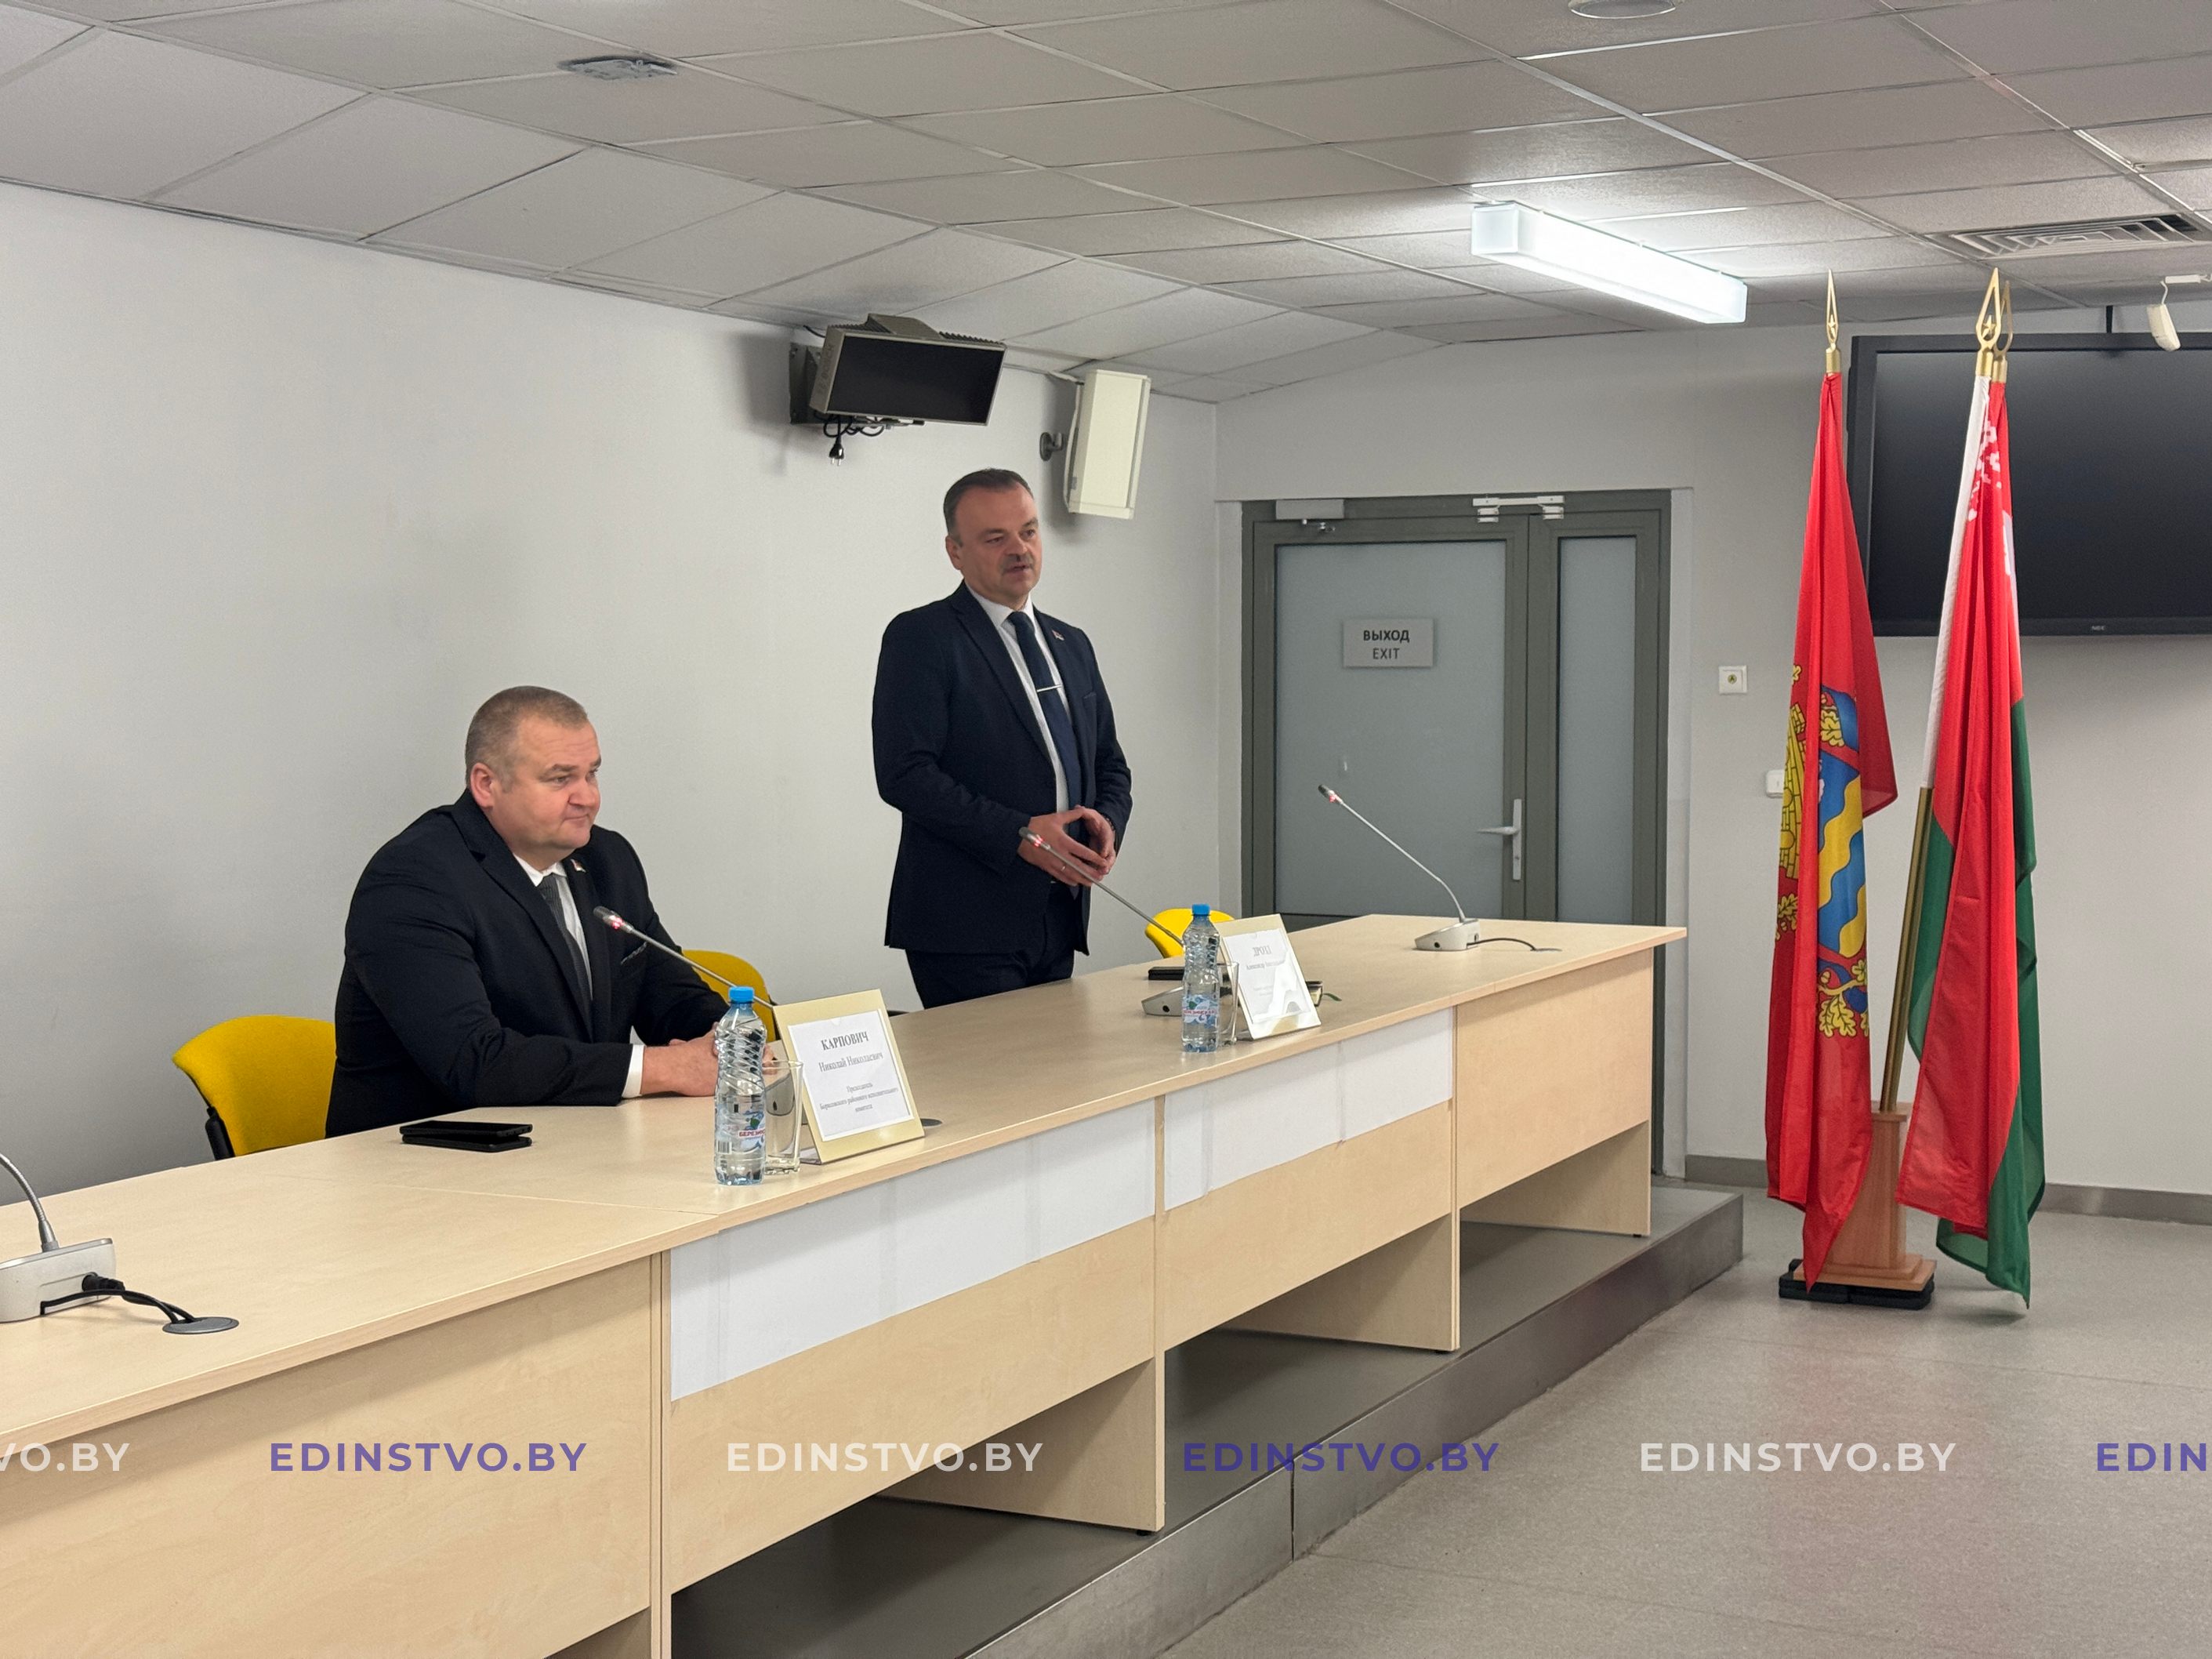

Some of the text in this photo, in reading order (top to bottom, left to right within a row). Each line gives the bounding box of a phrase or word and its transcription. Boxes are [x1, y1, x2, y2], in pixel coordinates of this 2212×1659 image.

[1363, 630, 1410, 644] ВЫХОД
[1373, 648, 1400, 659] EXIT
[821, 1031, 869, 1051] КАРПОВИЧ
[818, 1057, 847, 1073] Николай
